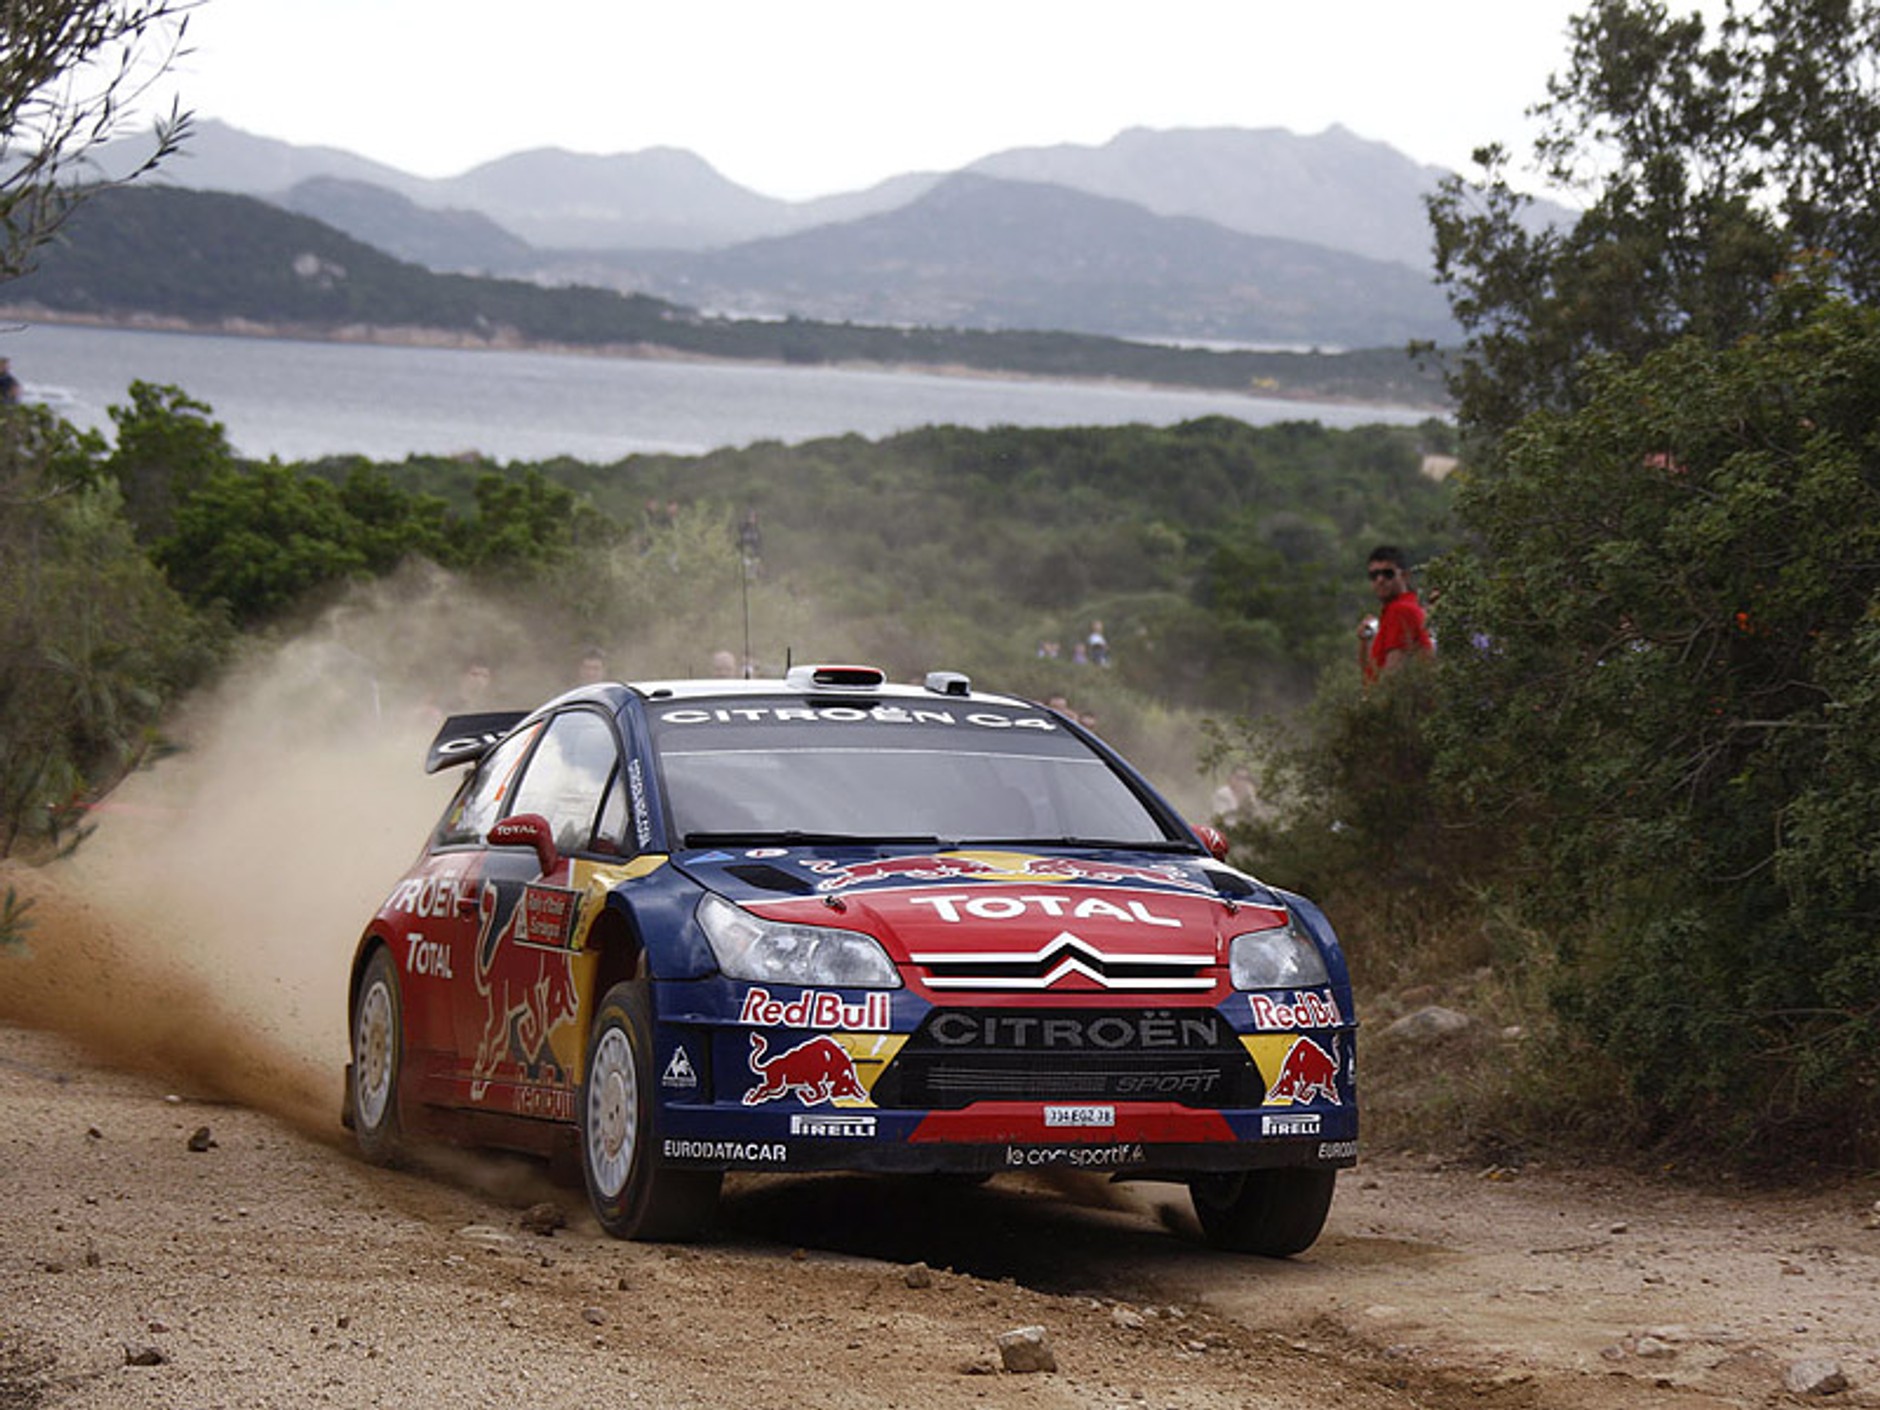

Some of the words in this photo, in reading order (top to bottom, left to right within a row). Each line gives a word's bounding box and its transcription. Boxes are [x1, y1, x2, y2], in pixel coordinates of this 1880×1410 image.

[661, 707, 956, 725] CITROËN
[966, 713, 1057, 730] C4
[497, 824, 539, 836] TOTAL
[910, 894, 1183, 927] TOTAL
[406, 932, 453, 979] TOTAL
[928, 1011, 1219, 1048] CITROËN
[1115, 1072, 1221, 1092] SPORT
[790, 1114, 878, 1136] PIRELLI
[1261, 1113, 1321, 1135] PIRELLI
[663, 1139, 787, 1161] EURODATACAR
